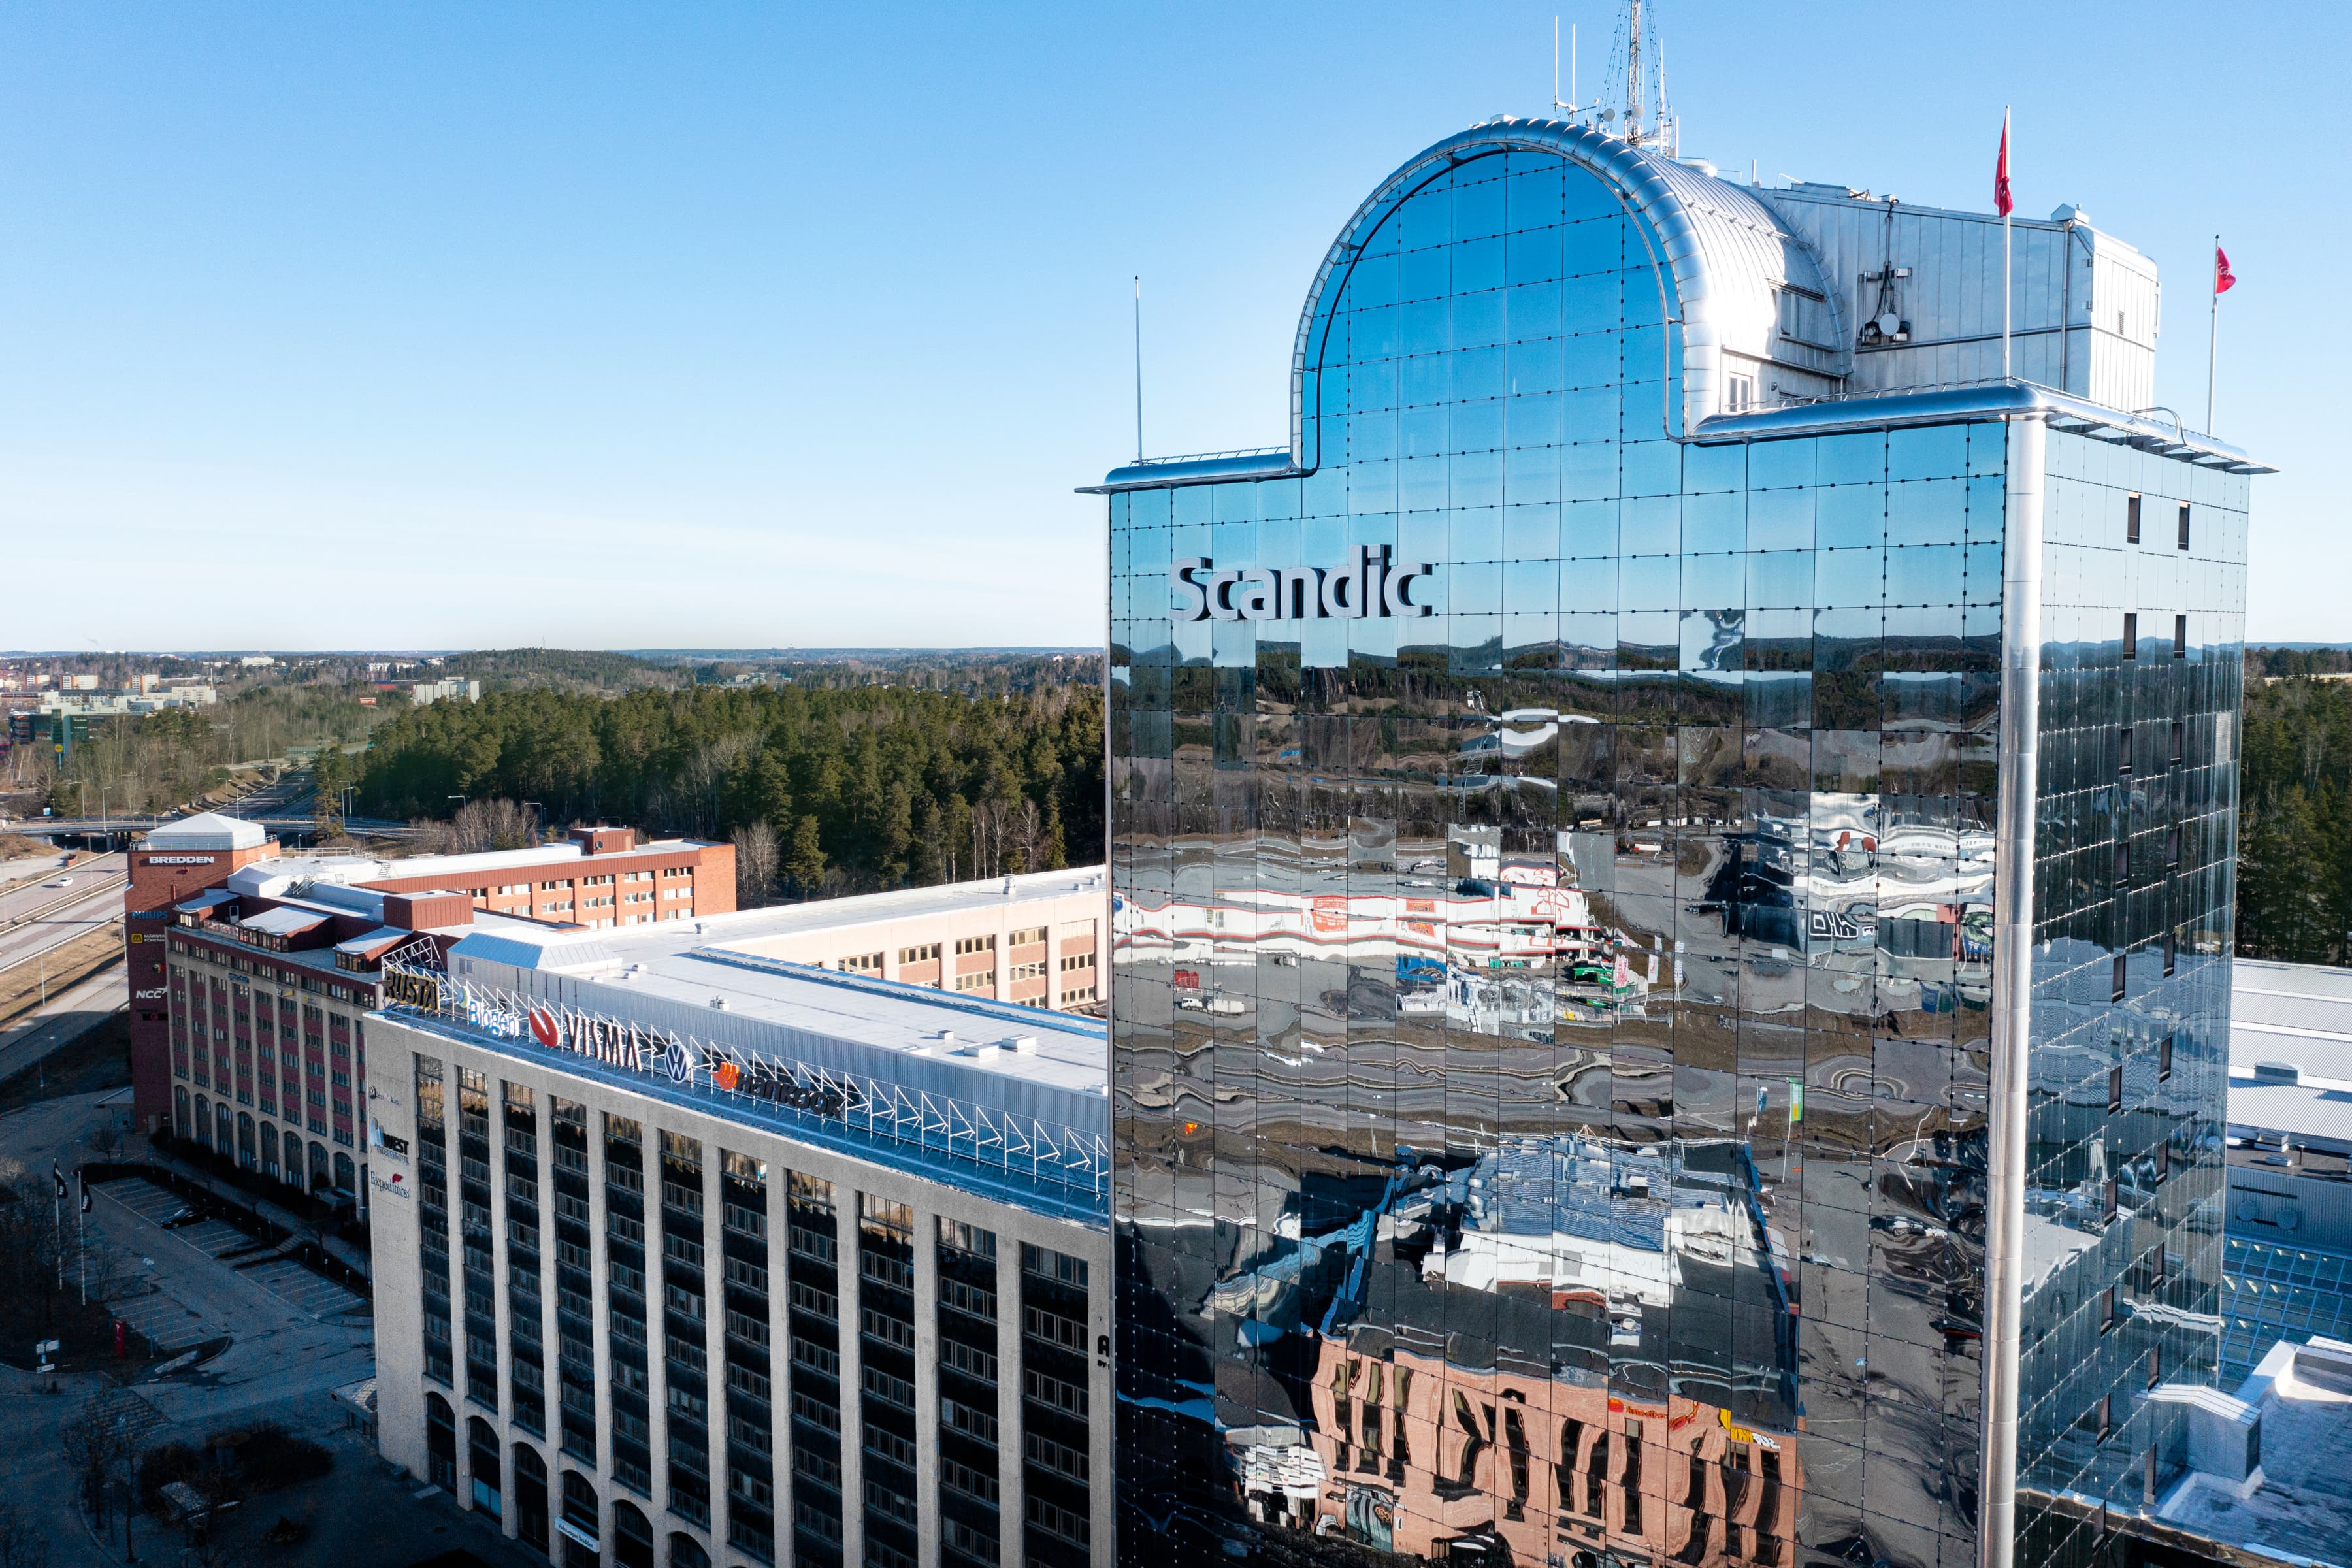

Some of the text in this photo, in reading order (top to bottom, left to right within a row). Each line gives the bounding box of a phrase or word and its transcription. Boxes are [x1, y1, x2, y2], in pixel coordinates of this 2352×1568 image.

[1169, 544, 1433, 621] Scandic
[131, 910, 168, 919] PHILIPS
[135, 990, 162, 999] NCC
[382, 968, 440, 1013] RUSTA
[469, 1000, 520, 1038] Biogen
[565, 1013, 643, 1072] VISMA
[370, 1171, 410, 1199] Expeditors
